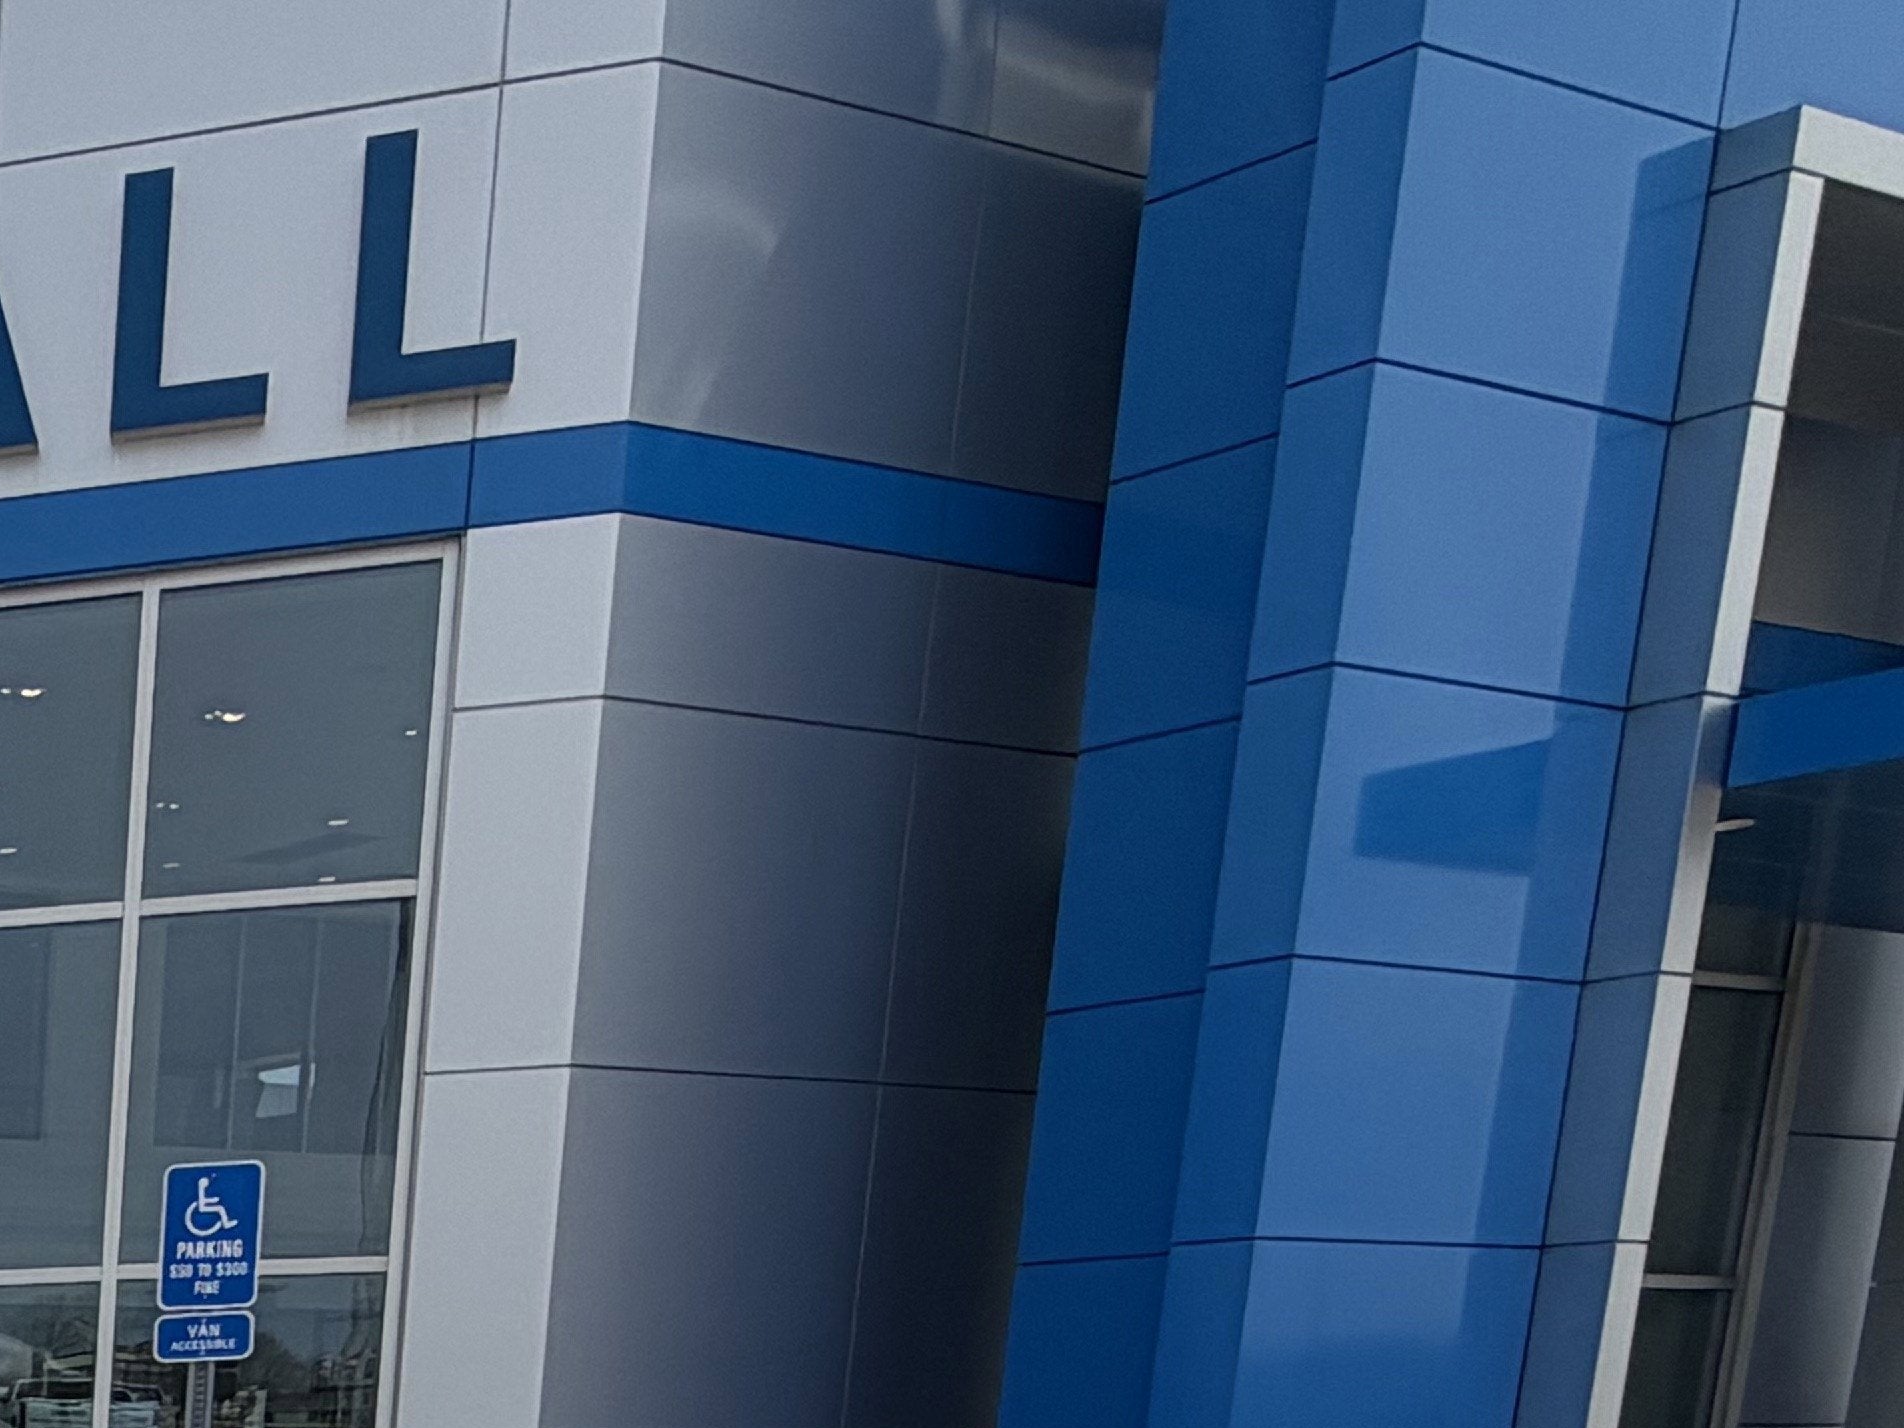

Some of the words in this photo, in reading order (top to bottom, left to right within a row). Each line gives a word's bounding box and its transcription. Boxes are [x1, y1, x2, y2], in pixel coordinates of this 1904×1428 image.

[176, 1239, 244, 1260] PARKING
[197, 1262, 212, 1277] TO
[193, 1280, 220, 1295] FINE
[186, 1324, 221, 1339] VAN
[170, 1338, 236, 1352] ACCESSIBLE
